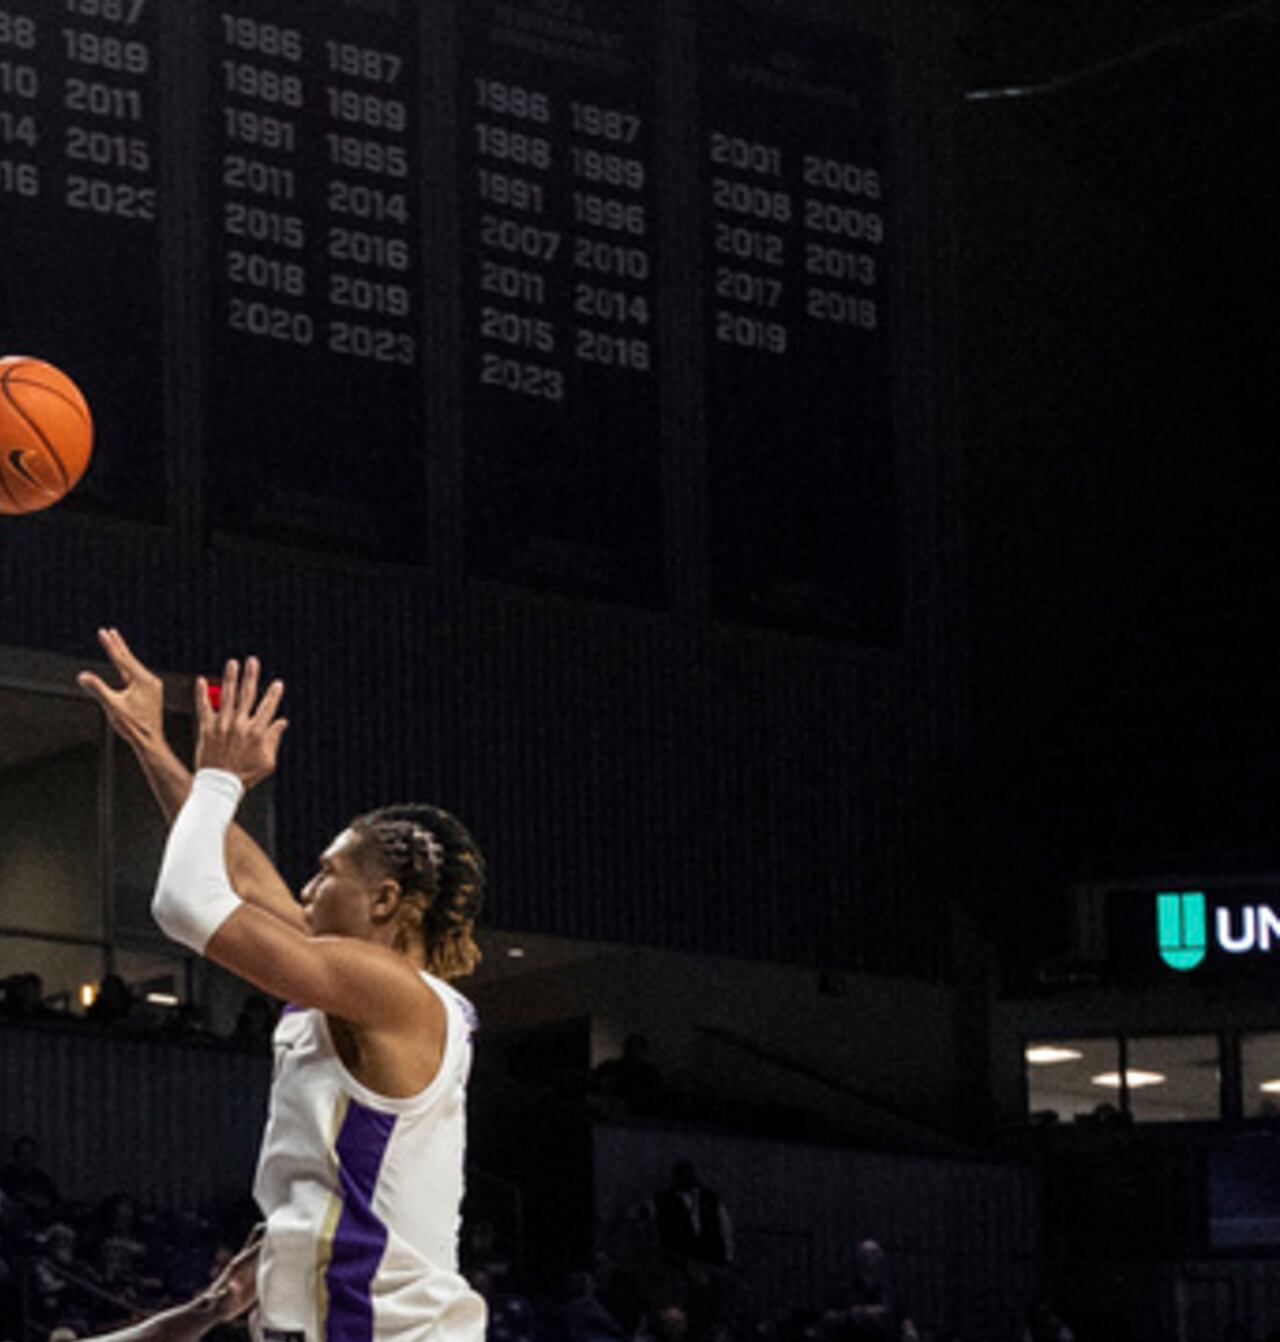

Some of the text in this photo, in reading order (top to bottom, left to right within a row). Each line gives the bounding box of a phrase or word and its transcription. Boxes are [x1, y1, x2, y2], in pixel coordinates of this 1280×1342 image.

[61, 28, 149, 74] 1989
[221, 14, 402, 83] 1986 1987
[64, 78, 140, 121] 2011
[221, 60, 407, 132] 1988 1989
[474, 77, 641, 144] 1986 1987
[64, 126, 150, 172] 2015
[223, 107, 408, 178] 1991 1995
[475, 123, 551, 170] 1988
[223, 155, 409, 225] 2011 2014
[478, 168, 542, 214] 1991
[804, 199, 884, 244] 2009
[224, 202, 409, 271] 2015 2016
[480, 215, 649, 280] 2007 2010
[715, 222, 877, 287] 2012 2013
[227, 250, 410, 317] 2018 2019
[481, 260, 649, 326] 2011 2014
[716, 265, 783, 308] 2017
[228, 299, 415, 366] 2020 2023
[481, 306, 554, 353] 2015
[480, 353, 564, 400] 2023
